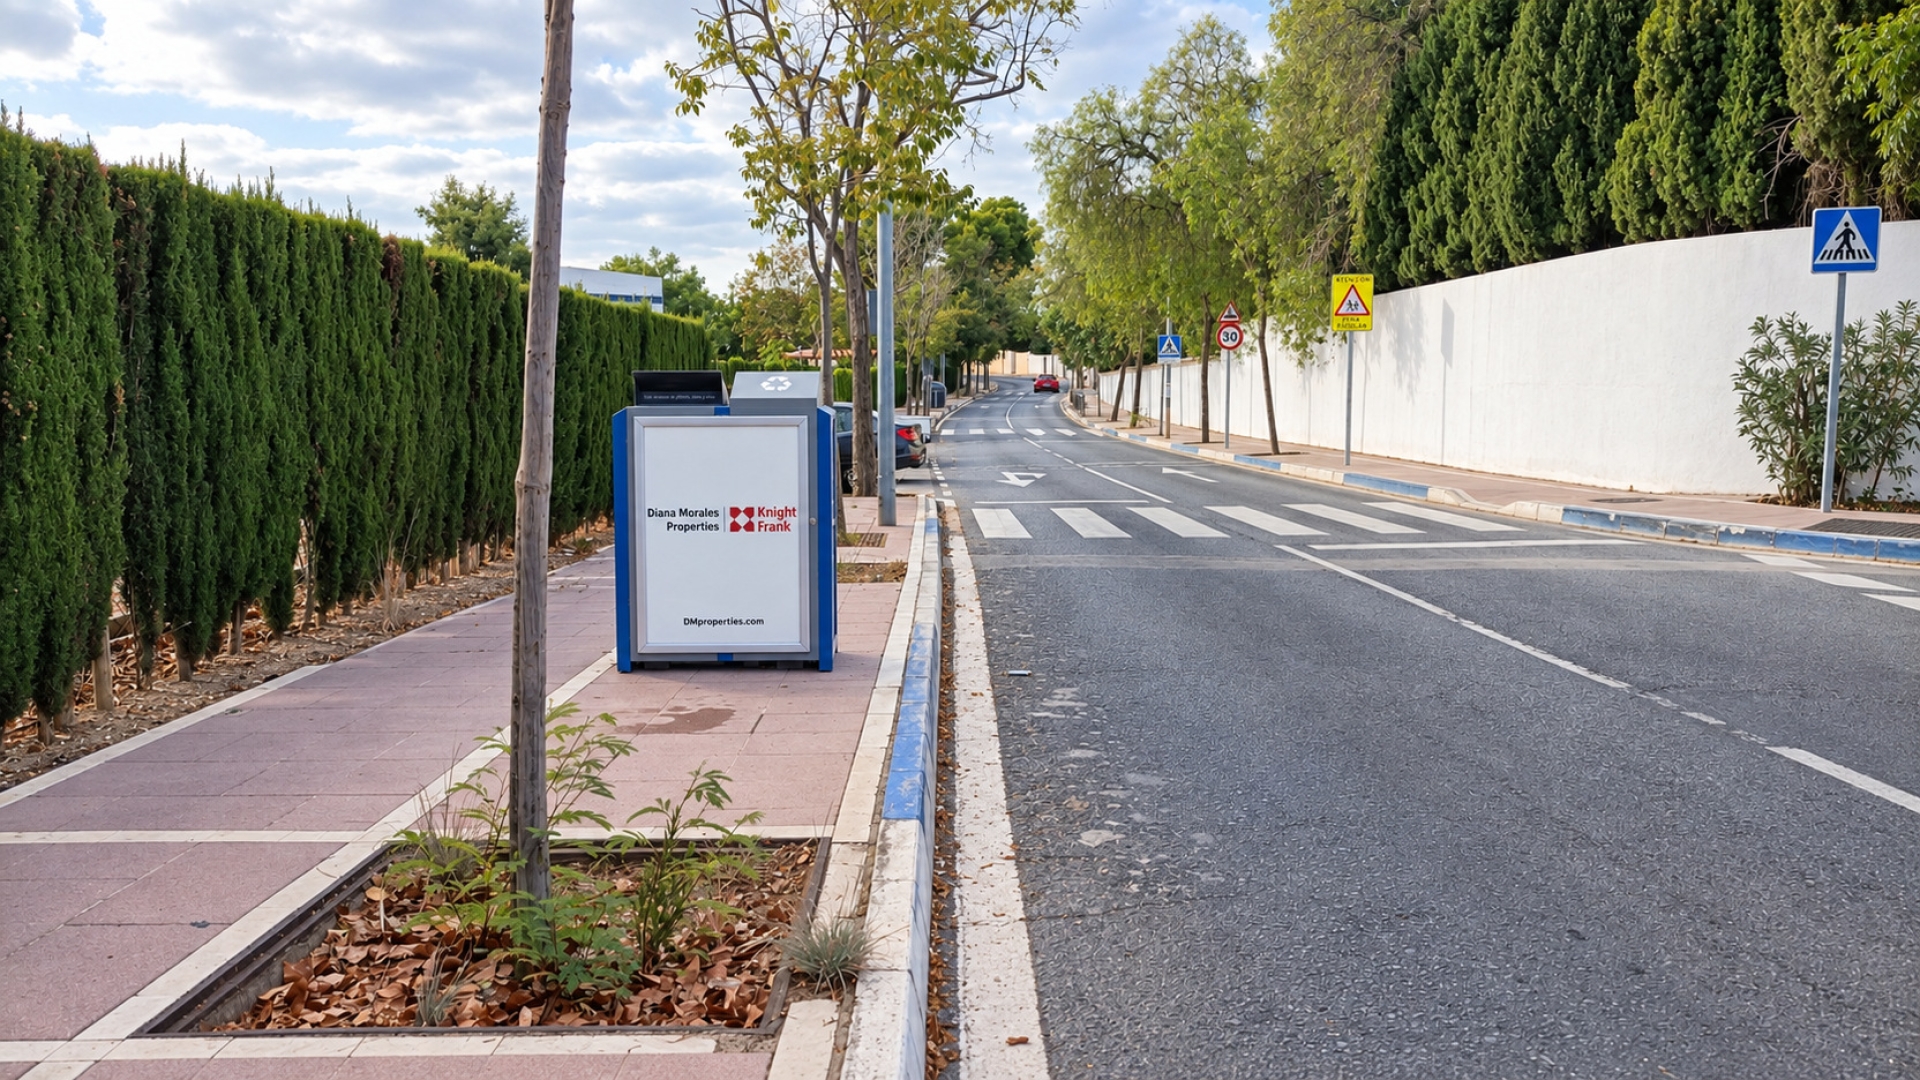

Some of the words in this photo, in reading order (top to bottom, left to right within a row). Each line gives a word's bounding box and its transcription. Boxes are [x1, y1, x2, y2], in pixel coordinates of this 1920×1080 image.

[1222, 331, 1238, 343] 30
[647, 507, 676, 518] Diana
[679, 507, 720, 518] Morales
[757, 506, 797, 520] Knight
[666, 521, 720, 533] Properties
[757, 520, 792, 532] Frank
[683, 617, 764, 628] DMproperties.com
